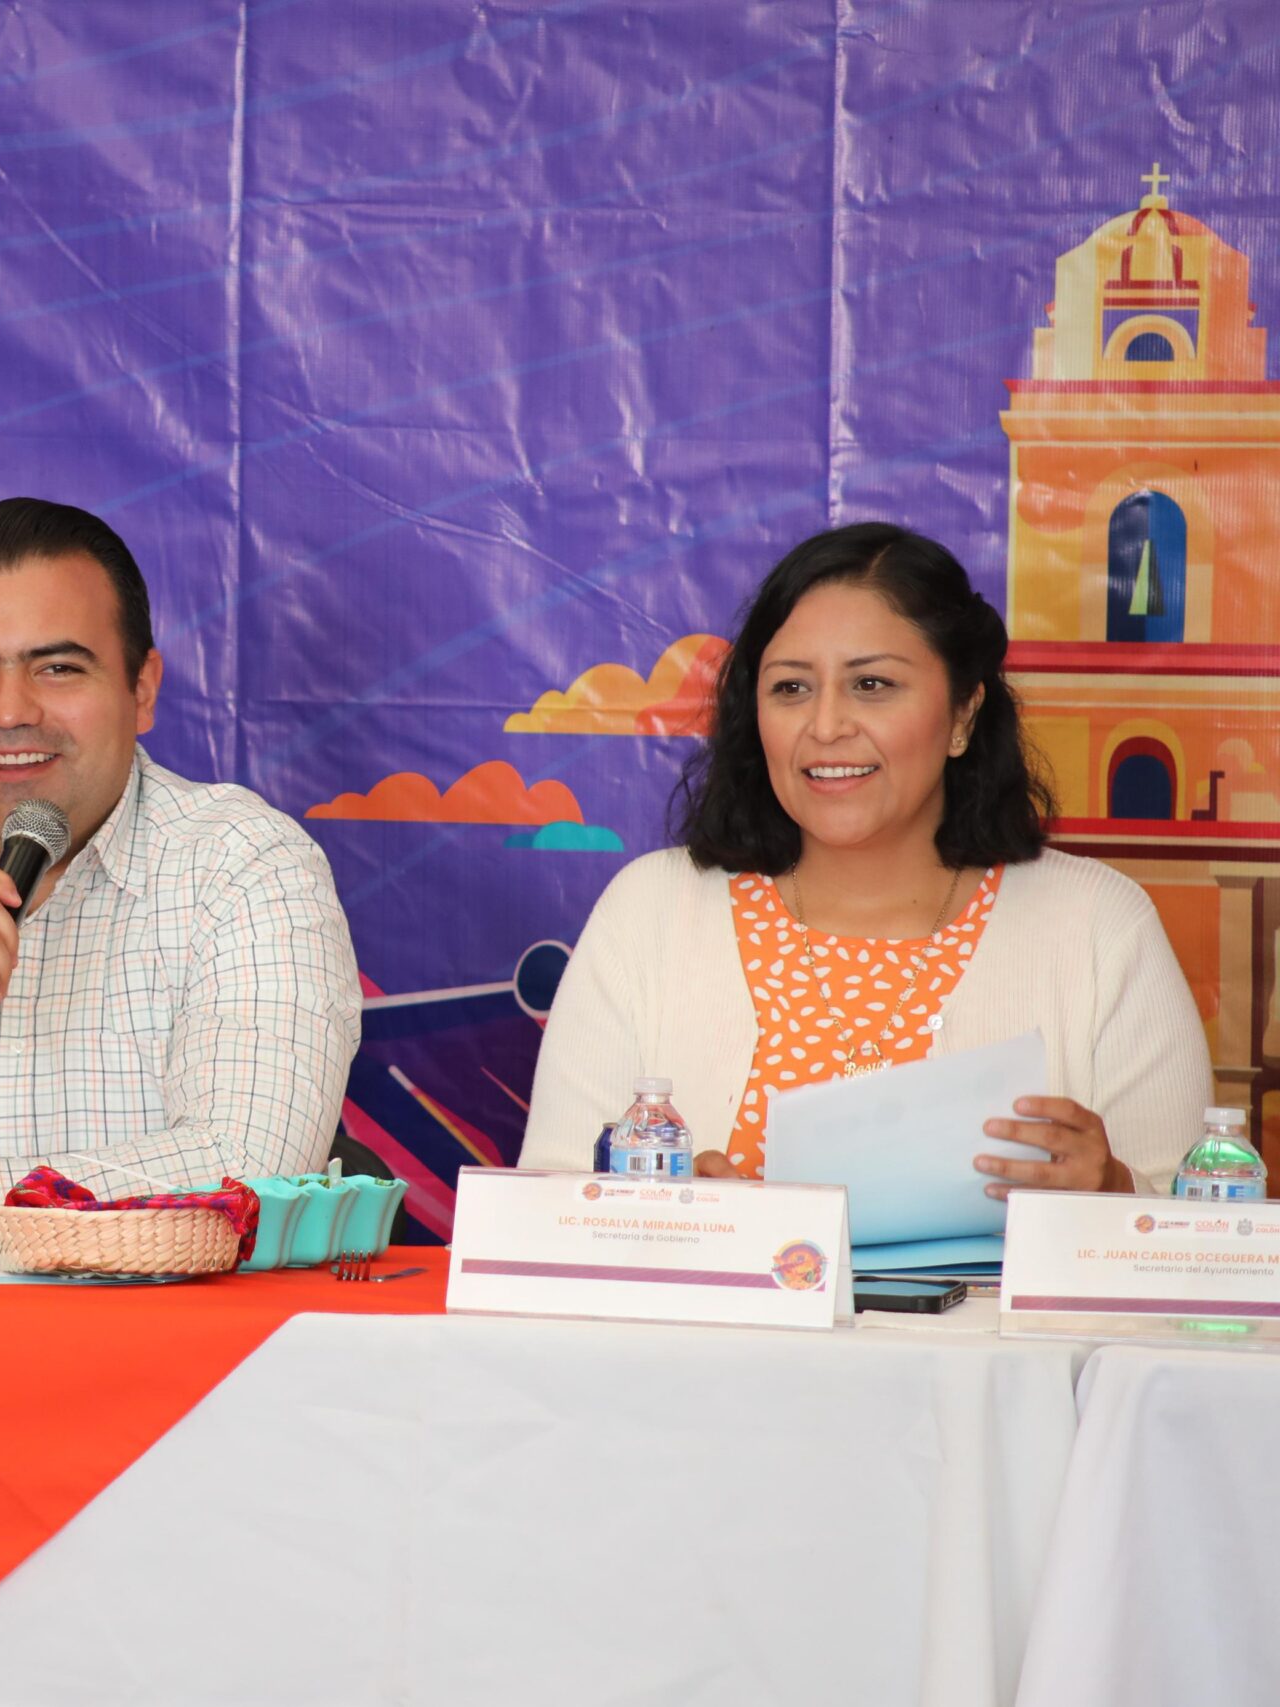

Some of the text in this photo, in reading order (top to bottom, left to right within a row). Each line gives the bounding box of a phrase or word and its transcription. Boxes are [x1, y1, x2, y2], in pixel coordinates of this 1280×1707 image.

[559, 1216, 736, 1233] LIC. ROSALVA MIRANDA LUNA
[642, 1233, 654, 1241] de
[657, 1234, 700, 1244] Gobierno
[1078, 1249, 1100, 1258] LIC.
[1103, 1249, 1137, 1260] JUAN
[1141, 1251, 1192, 1261] CARLOS
[1195, 1252, 1264, 1263] OCEGUERA
[1186, 1265, 1201, 1273] del
[1203, 1266, 1274, 1276] Ayuntamiento
